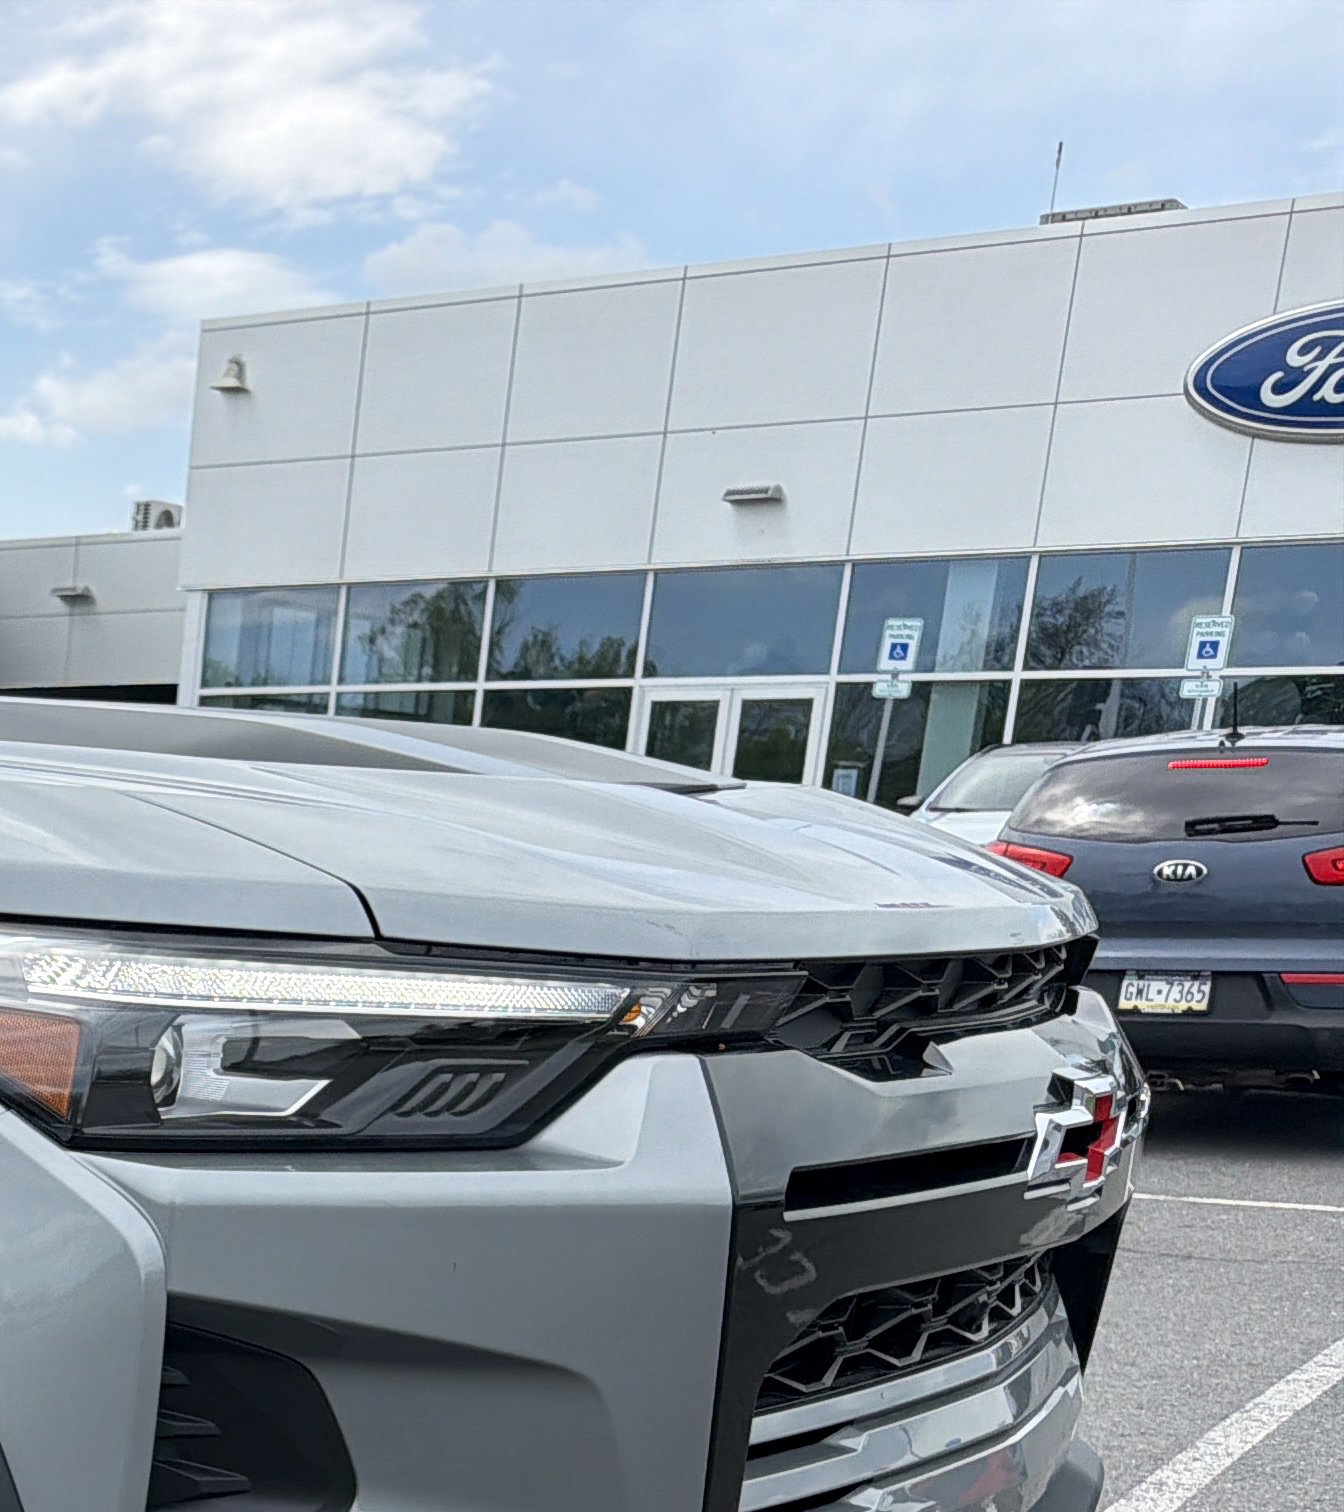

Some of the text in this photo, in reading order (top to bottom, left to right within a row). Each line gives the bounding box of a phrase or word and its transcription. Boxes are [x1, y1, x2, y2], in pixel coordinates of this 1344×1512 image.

[1193, 620, 1231, 629] RESERVED
[1196, 630, 1226, 638] PARKING
[1162, 864, 1197, 880] KIA
